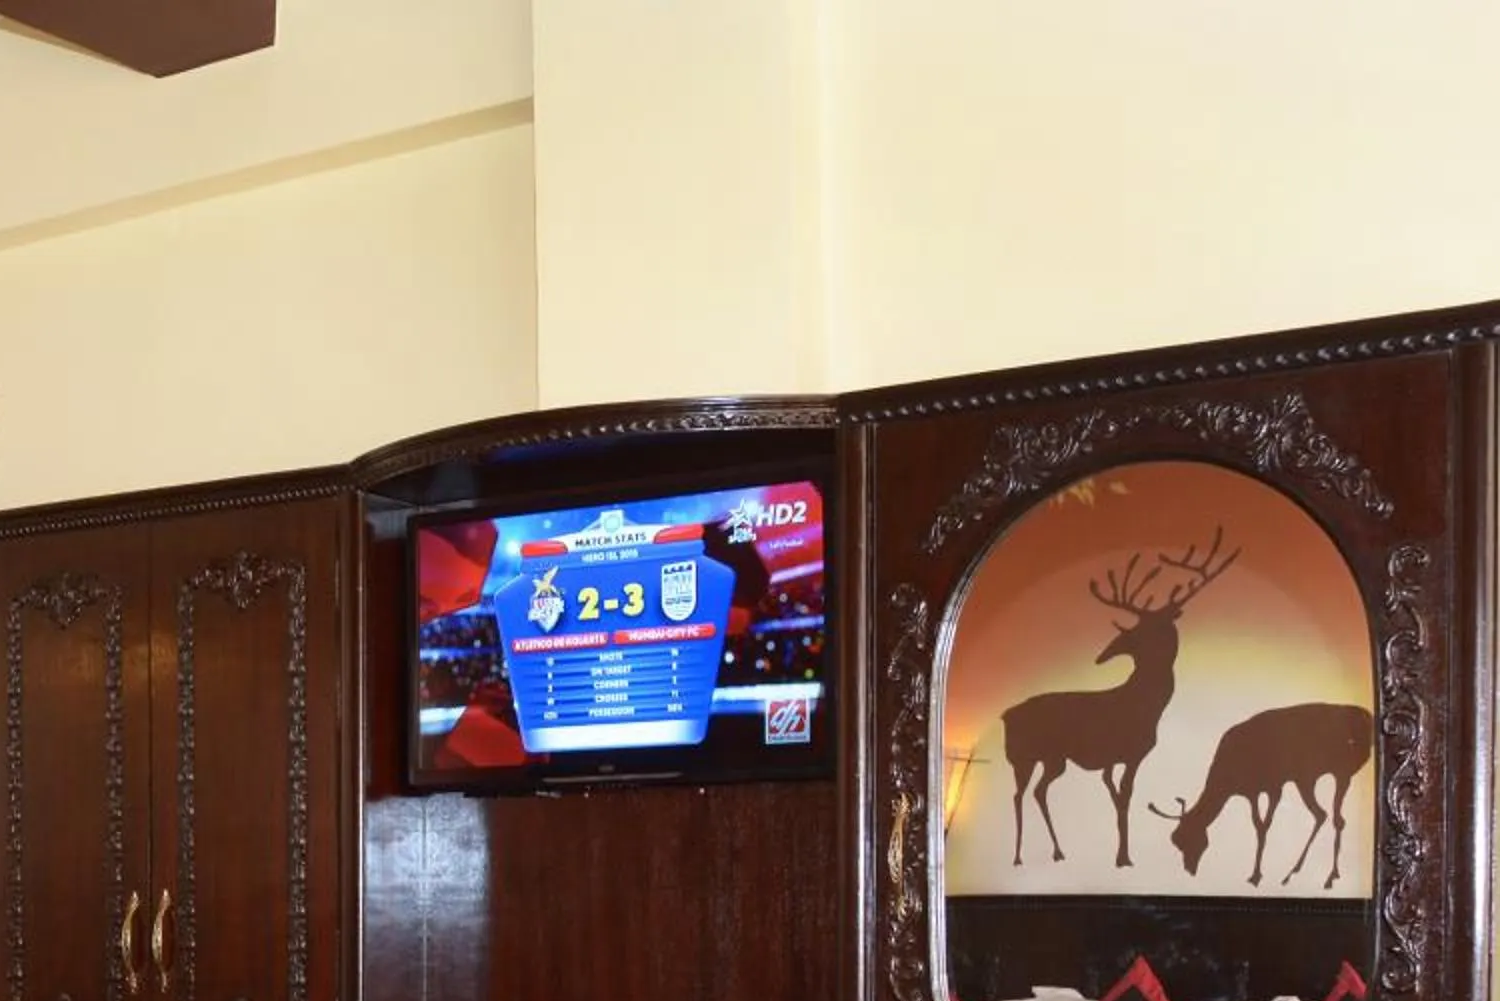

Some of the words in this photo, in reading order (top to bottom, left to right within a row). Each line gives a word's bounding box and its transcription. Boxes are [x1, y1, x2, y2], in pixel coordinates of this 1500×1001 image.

[756, 500, 807, 527] HD2
[575, 535, 612, 547] MATCH
[615, 531, 647, 544] STATS
